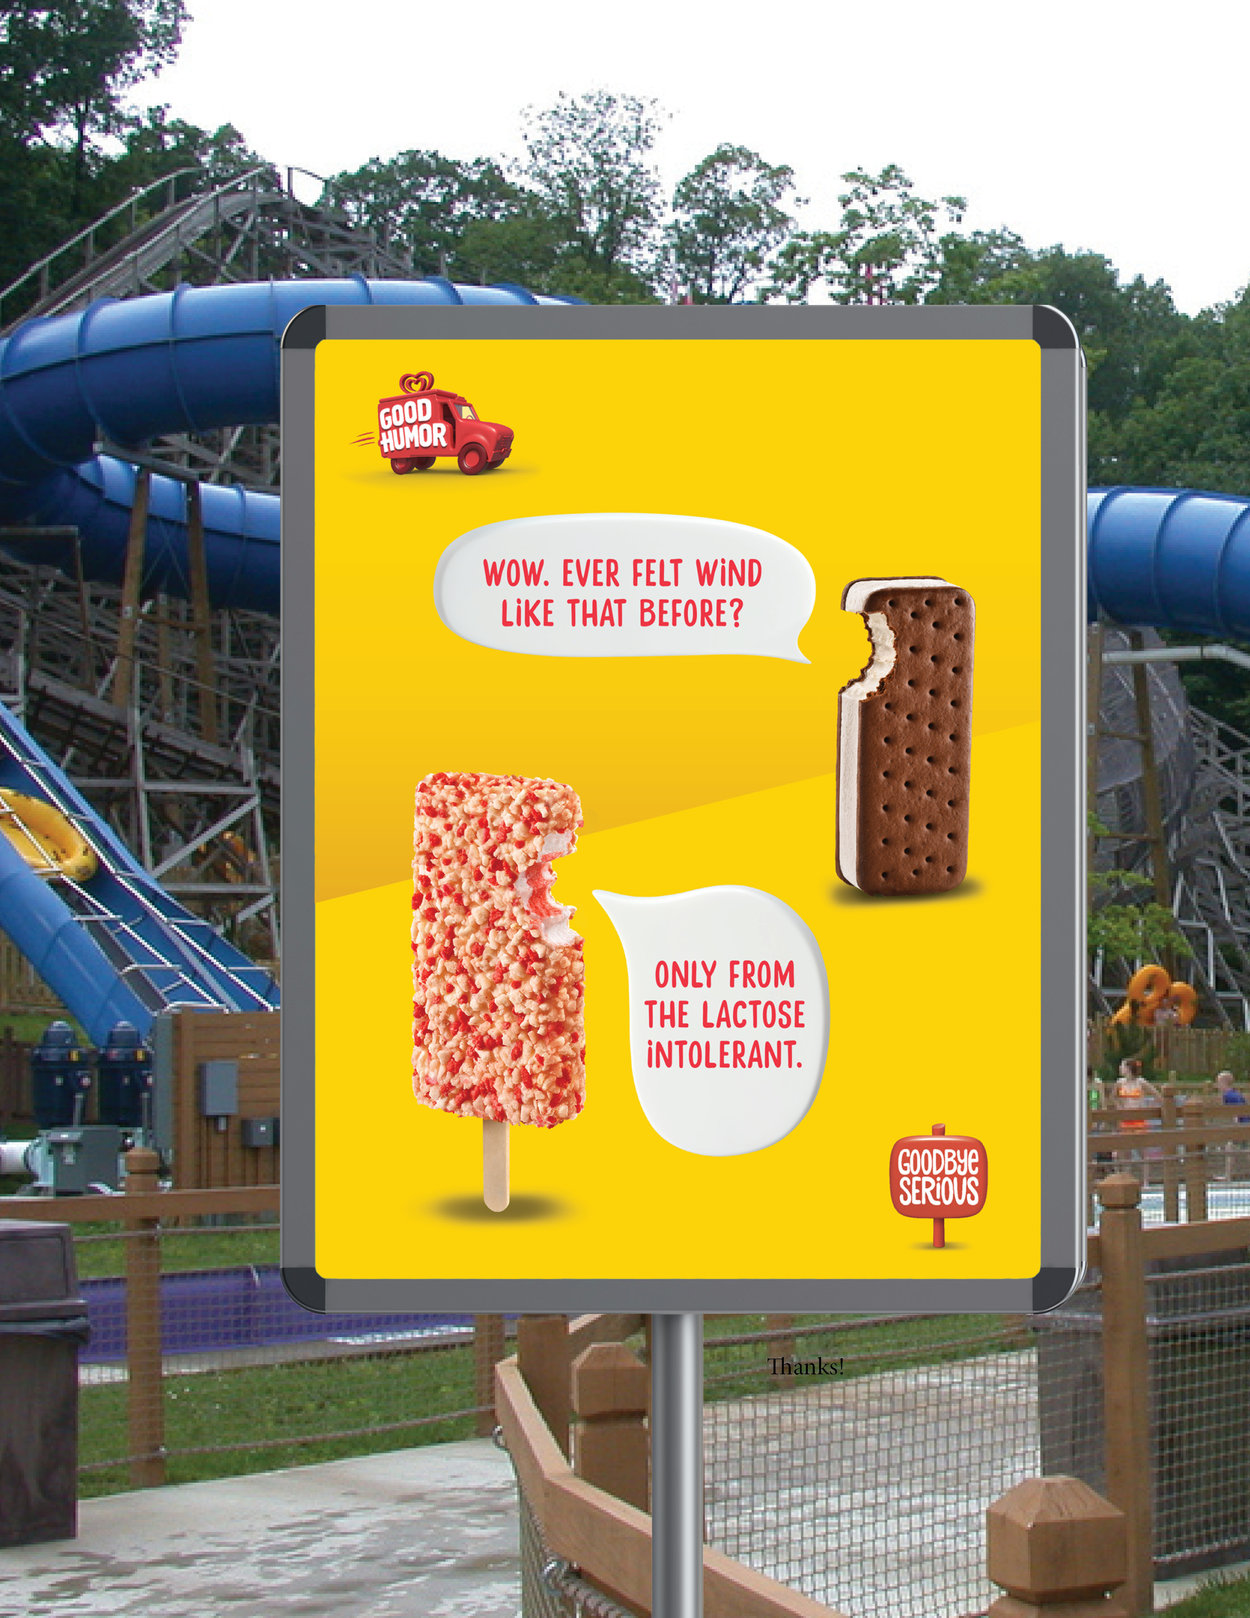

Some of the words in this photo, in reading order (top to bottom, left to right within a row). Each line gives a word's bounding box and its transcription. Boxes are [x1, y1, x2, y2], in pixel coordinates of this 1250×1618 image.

[379, 398, 433, 430] GOOD
[380, 422, 448, 453] HUMOR
[483, 559, 549, 587] WOW.
[563, 559, 619, 587] EVER
[633, 559, 682, 586] FELT
[567, 598, 626, 627] THAT
[640, 598, 743, 628] BEFORE?
[655, 960, 716, 988] ONLY
[730, 960, 794, 988] FROM
[644, 1000, 688, 1028] THE
[703, 1000, 805, 1029] LACTOSE
